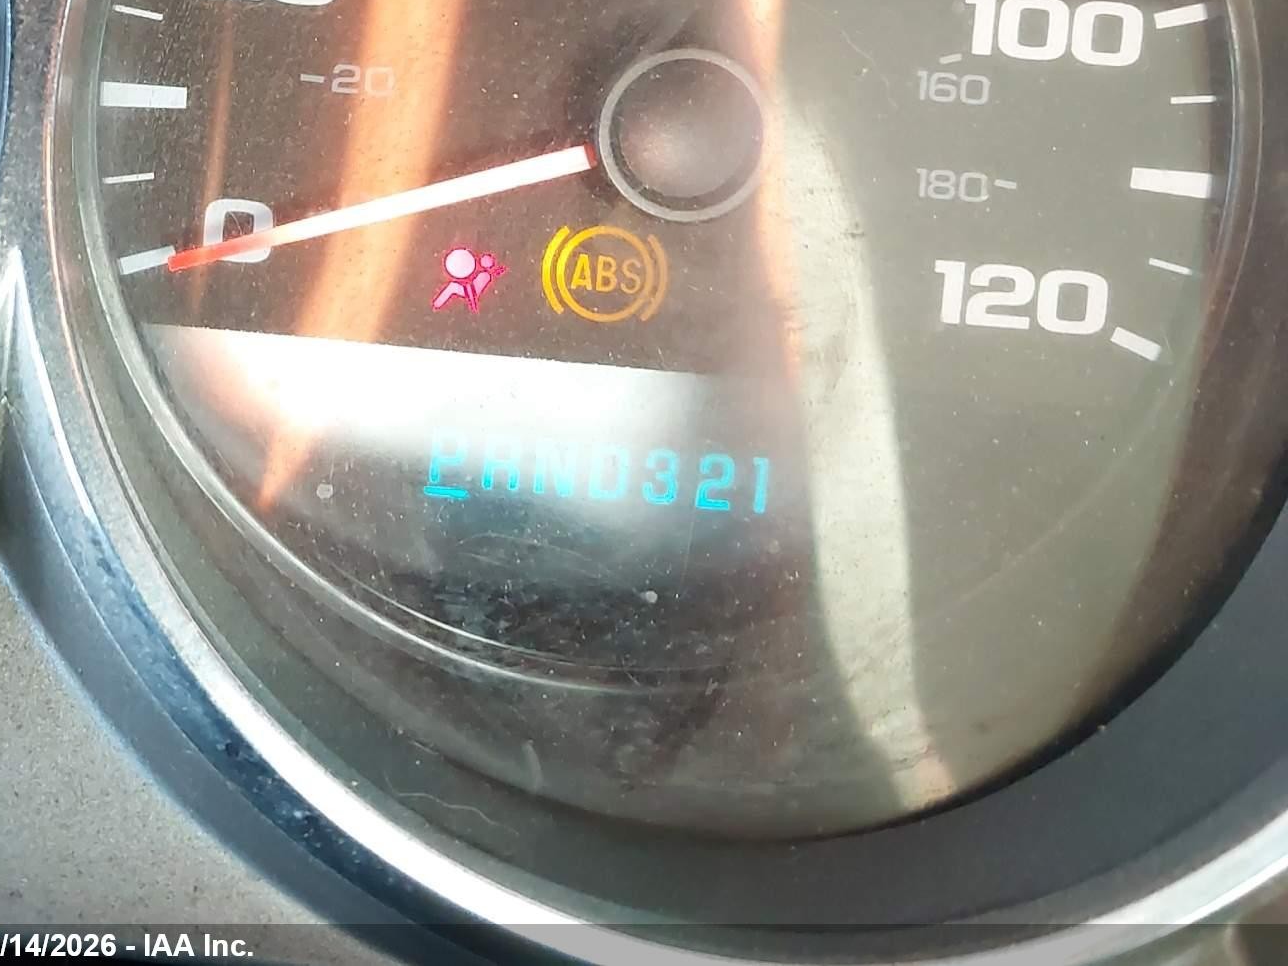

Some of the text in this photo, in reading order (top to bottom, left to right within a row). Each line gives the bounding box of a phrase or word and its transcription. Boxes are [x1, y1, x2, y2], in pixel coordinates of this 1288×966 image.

[330, 65, 395, 96] 20
[917, 70, 991, 106] 160
[917, 169, 989, 202] 180
[203, 198, 275, 264] 0
[570, 254, 642, 295] ABS
[933, 259, 1109, 337] 120
